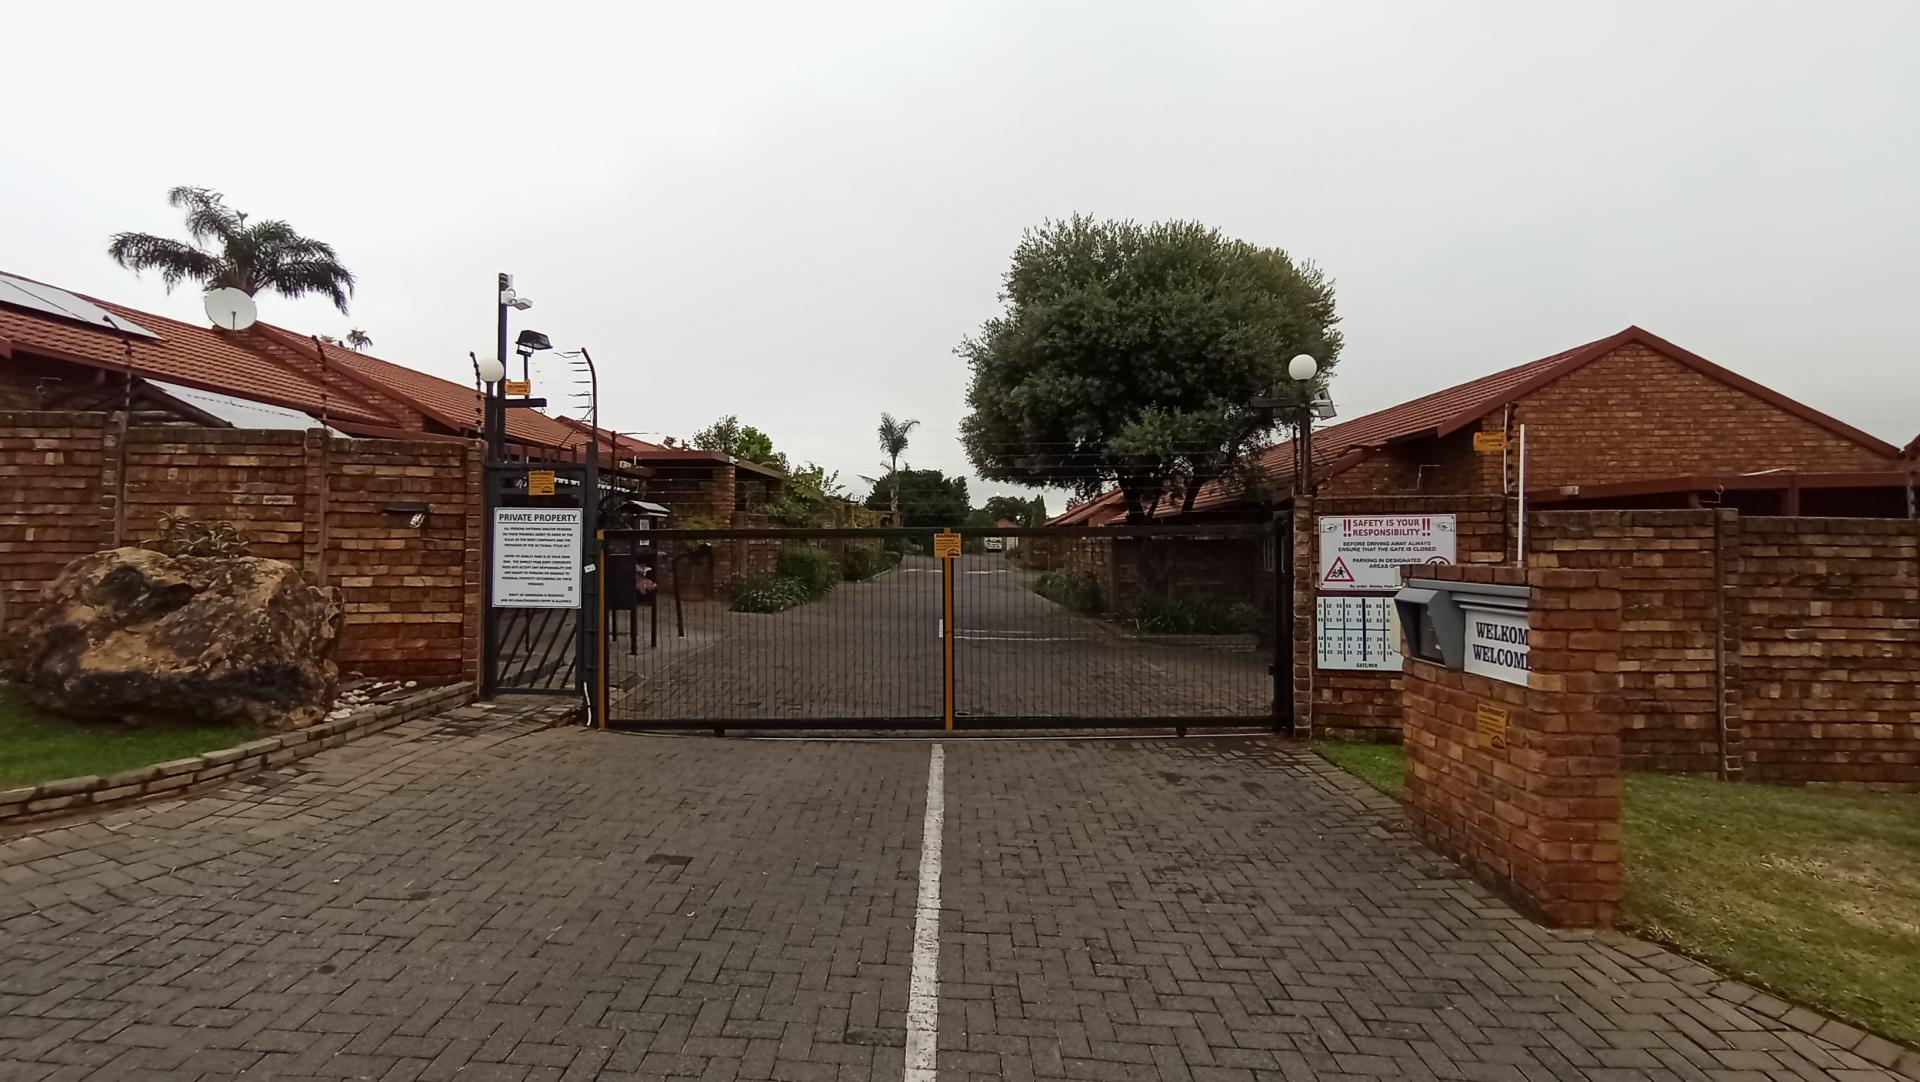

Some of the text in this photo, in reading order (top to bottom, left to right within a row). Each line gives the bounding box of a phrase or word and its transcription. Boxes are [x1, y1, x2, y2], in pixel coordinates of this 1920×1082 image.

[499, 513, 577, 522] PRIVATE PROPERTY
[1353, 528, 1420, 536] RESPONSIBILITY
[1476, 622, 1530, 646] WELKOM
[1472, 644, 1532, 671] WELCOM
